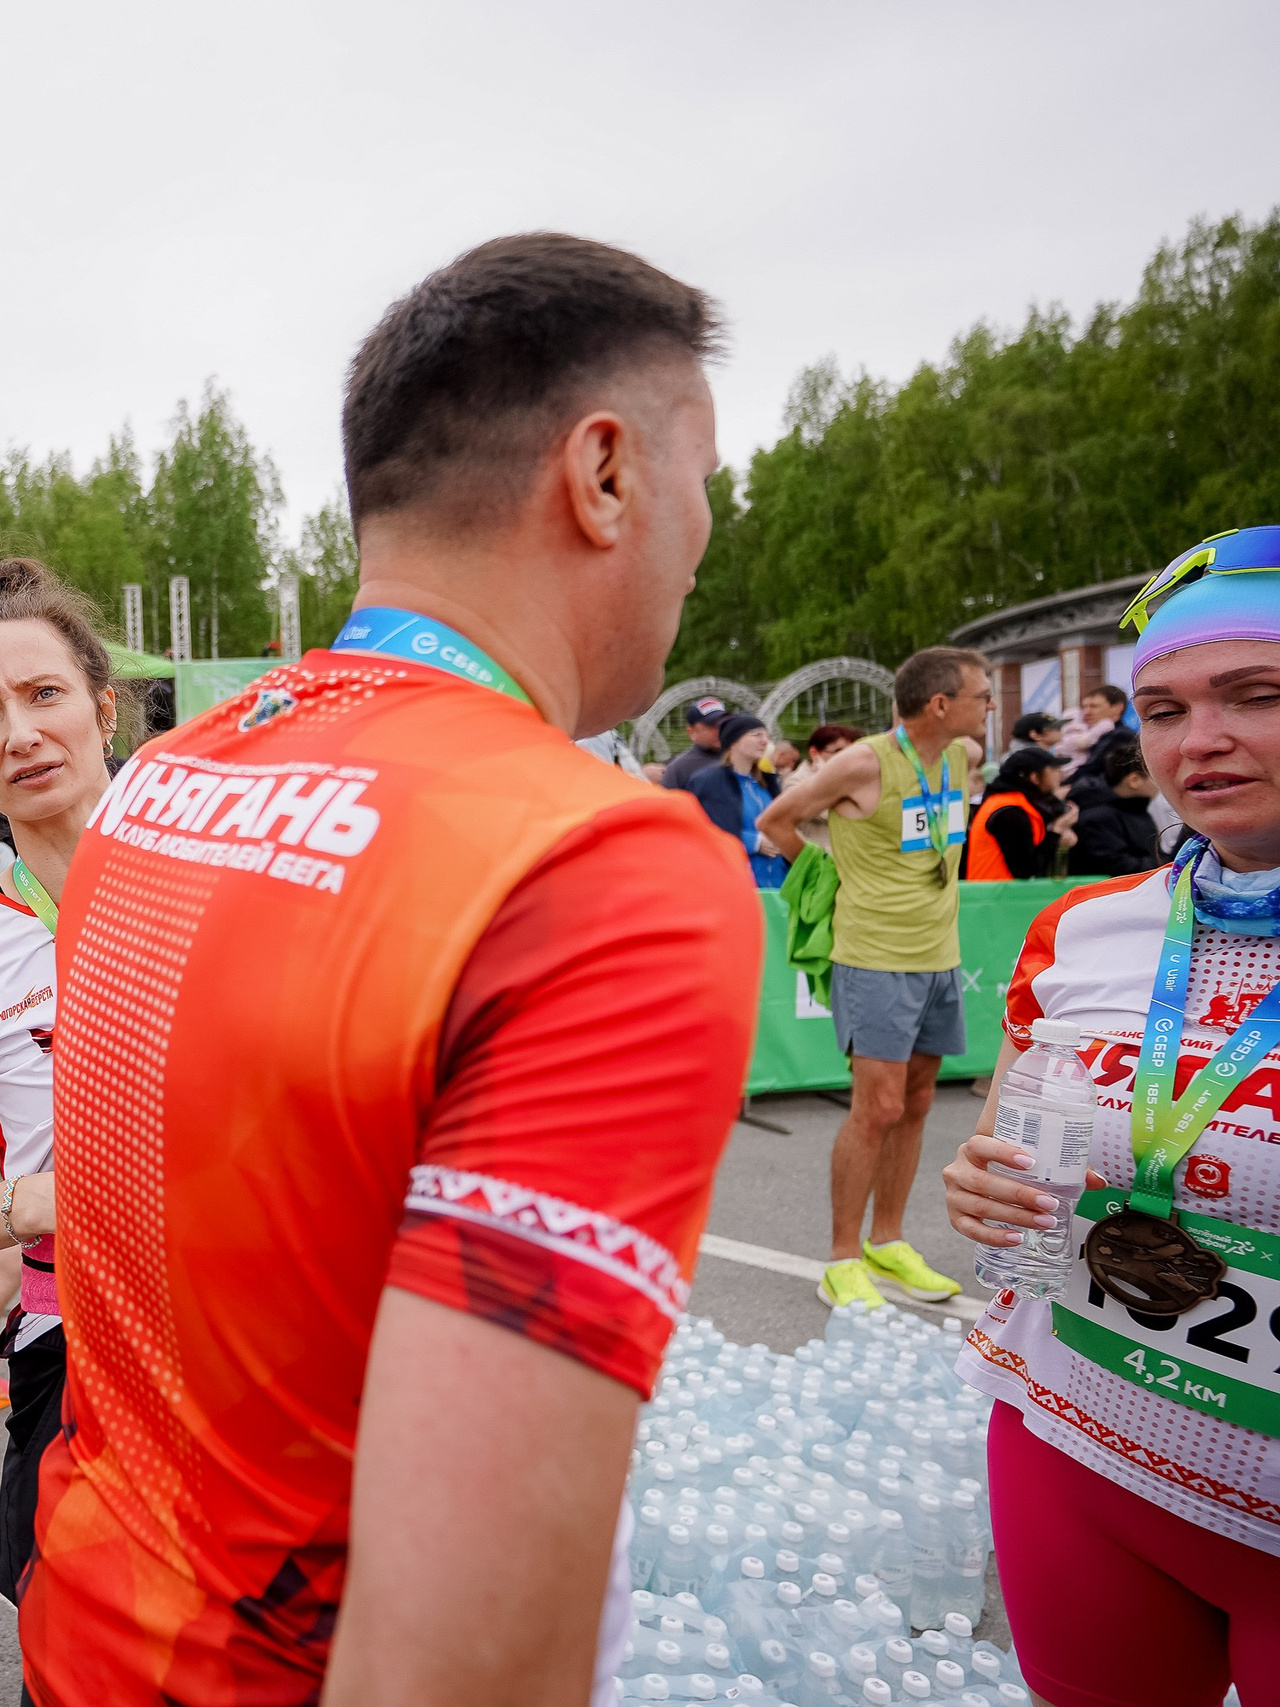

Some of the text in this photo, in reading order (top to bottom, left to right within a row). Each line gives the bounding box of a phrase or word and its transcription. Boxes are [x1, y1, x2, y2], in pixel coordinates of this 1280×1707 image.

[439, 645, 493, 683] СБЕР
[126, 760, 381, 858] НЯГАНЬ
[112, 820, 347, 895] КЛУБ ЛЮБИТЕЛЕЙ БЕГА
[1151, 1035, 1168, 1068] СБЕР
[1230, 1030, 1262, 1062] СБЕР
[1145, 1082, 1160, 1133] 185 лет
[1173, 1089, 1213, 1134] 185 лет
[1204, 1120, 1280, 1145] ИТЕЛЕ
[1123, 1348, 1181, 1391] 4,2
